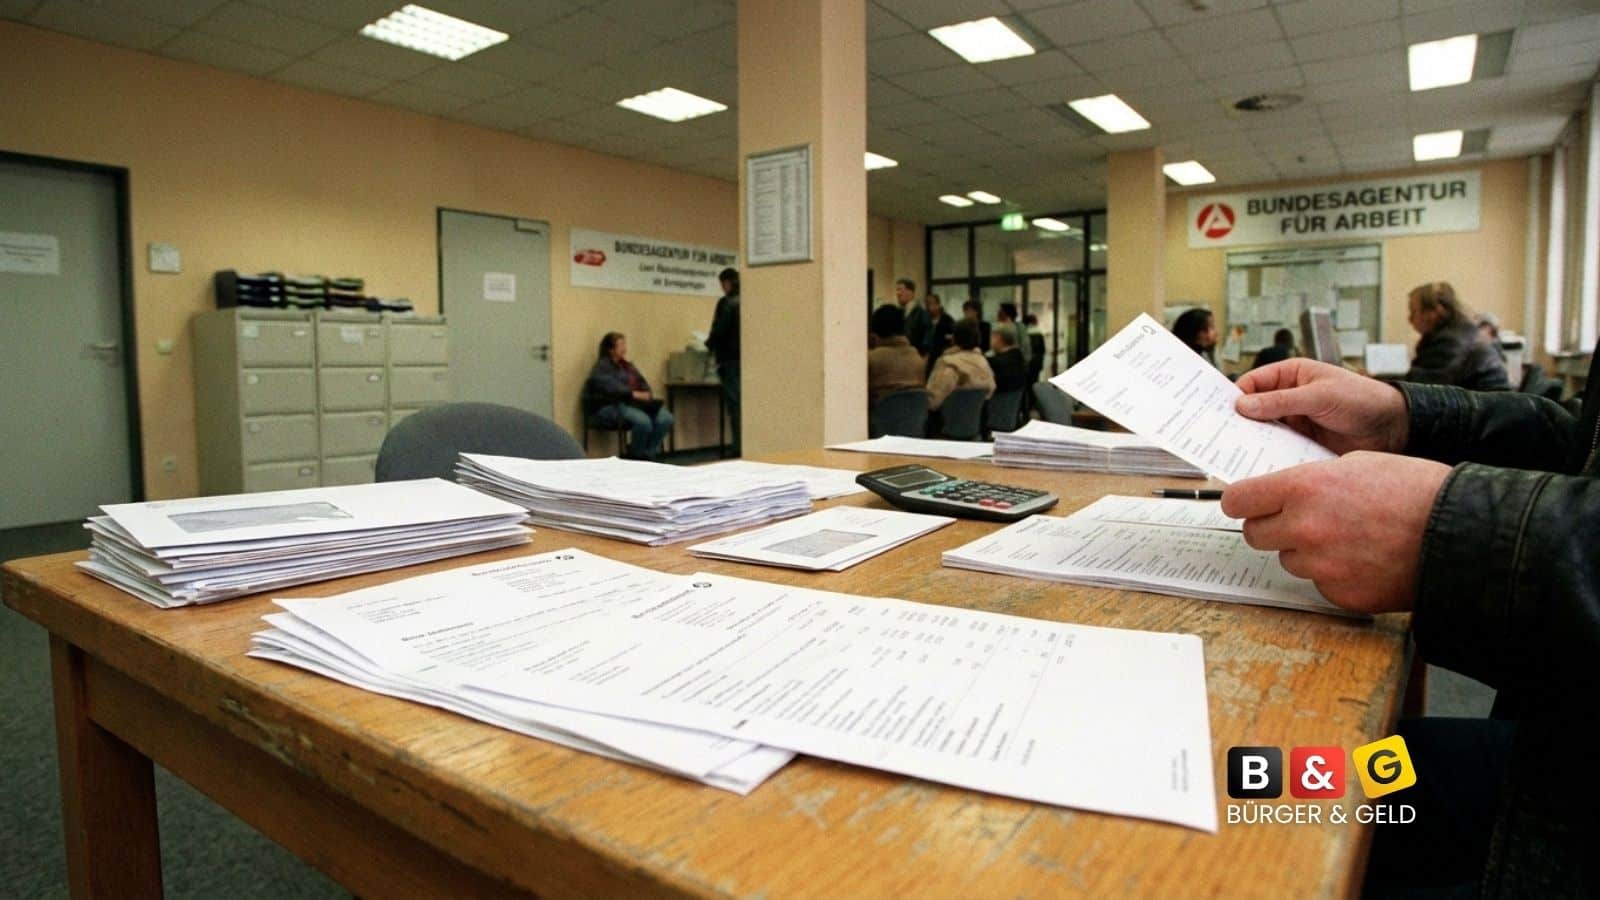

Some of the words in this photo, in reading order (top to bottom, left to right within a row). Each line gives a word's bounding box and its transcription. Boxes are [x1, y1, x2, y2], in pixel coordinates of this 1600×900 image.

[1246, 180, 1468, 216] BUNDESAGENTUR
[1280, 213, 1326, 235] FÜR
[1335, 207, 1427, 231] ARBEIT
